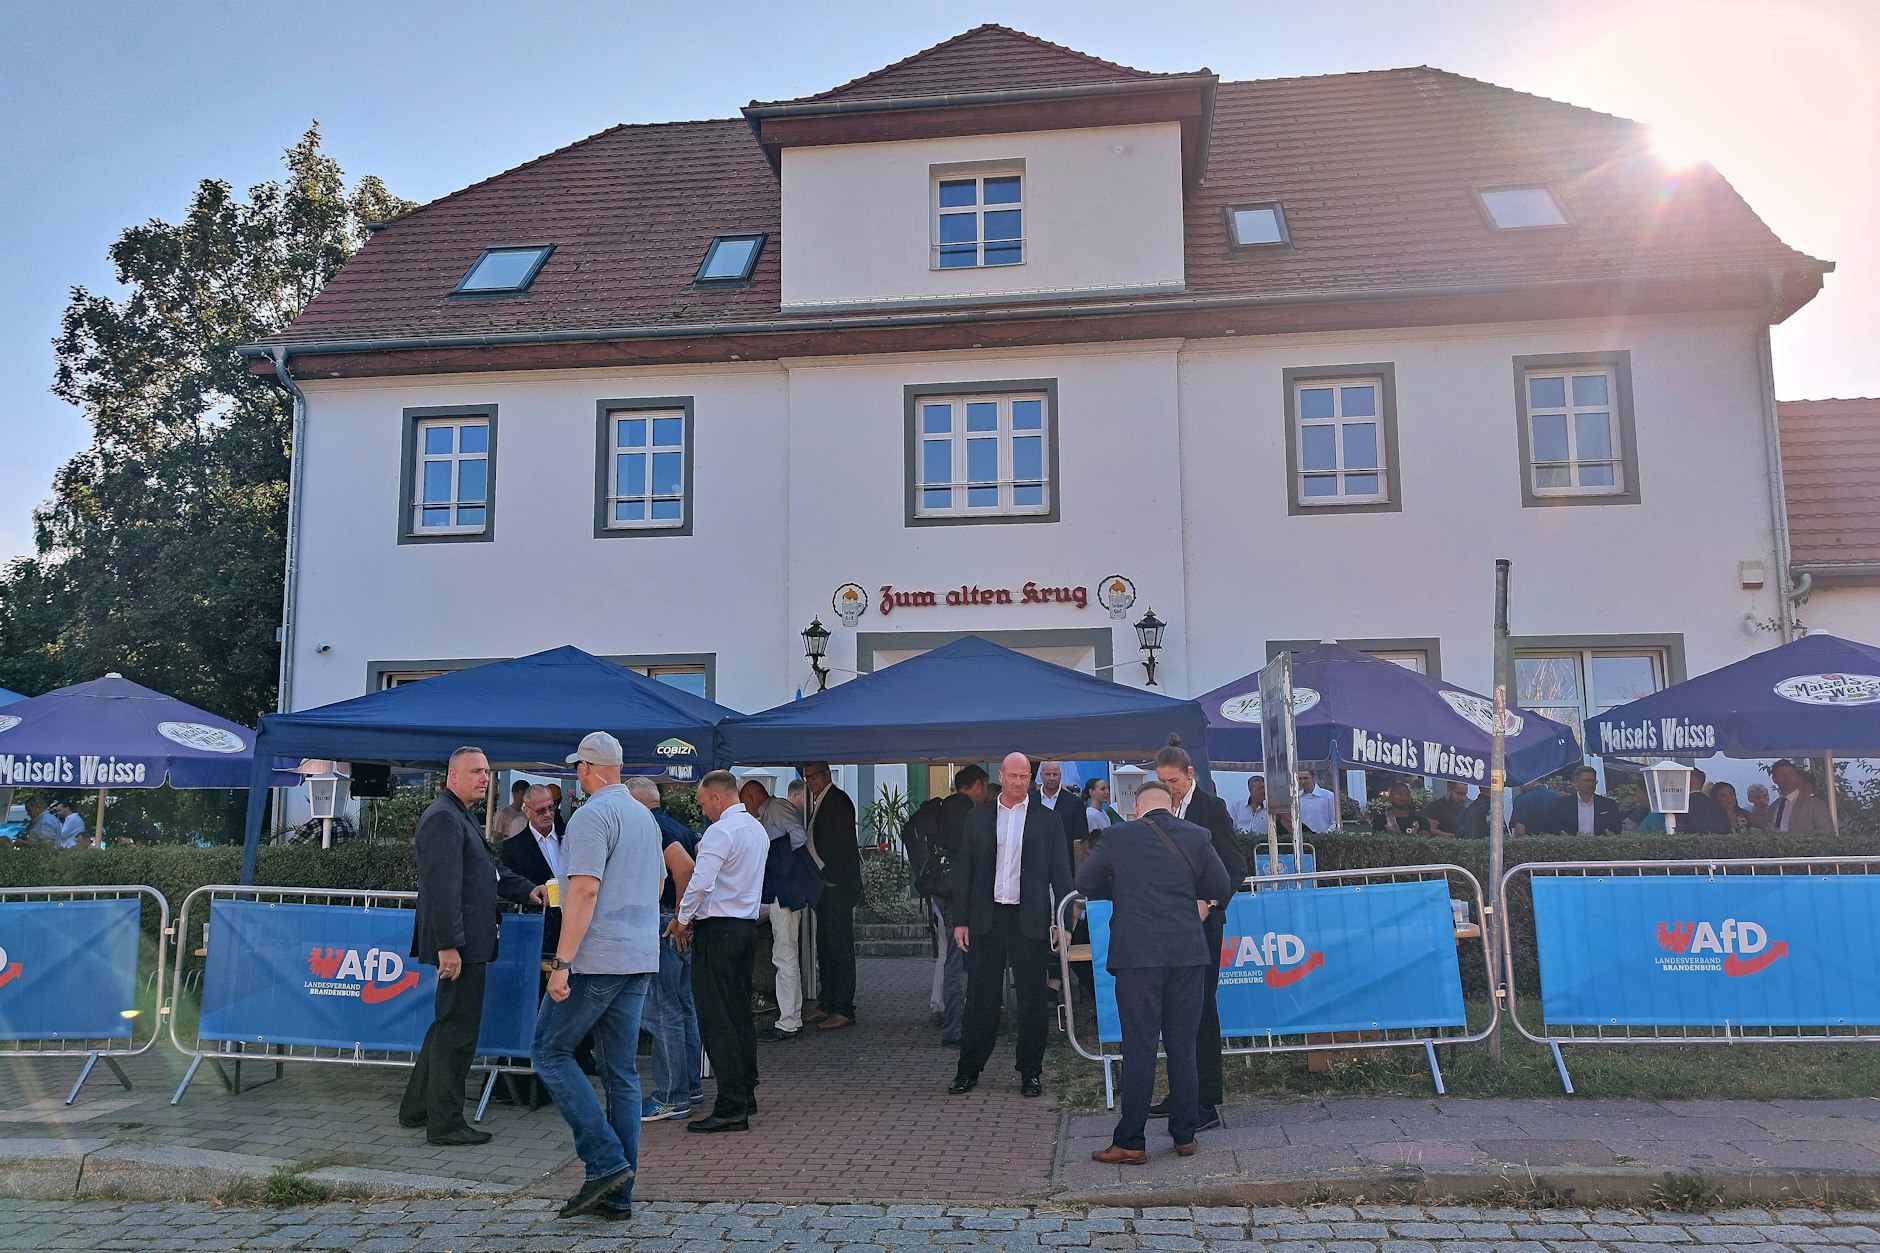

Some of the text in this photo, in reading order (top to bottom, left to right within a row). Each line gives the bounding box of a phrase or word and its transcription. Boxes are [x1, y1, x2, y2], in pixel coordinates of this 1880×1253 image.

[878, 581, 1088, 615] Zum alten Krug
[1830, 682, 1880, 698] Weiss
[656, 746, 691, 755] COBIZI
[1599, 717, 1715, 753] Maisel's Weisse
[0, 754, 146, 785] Maisel's Weisse
[1352, 728, 1485, 780] Maisel's Weisse
[1234, 931, 1305, 968] AfD
[1690, 918, 1767, 954] AfD
[336, 947, 404, 982] AfD
[1218, 970, 1263, 979] ESVERBAND
[304, 981, 361, 990] LANDESVERBAND
[309, 989, 361, 997] BRANDENBURG
[1217, 977, 1264, 985] ANDENBURG
